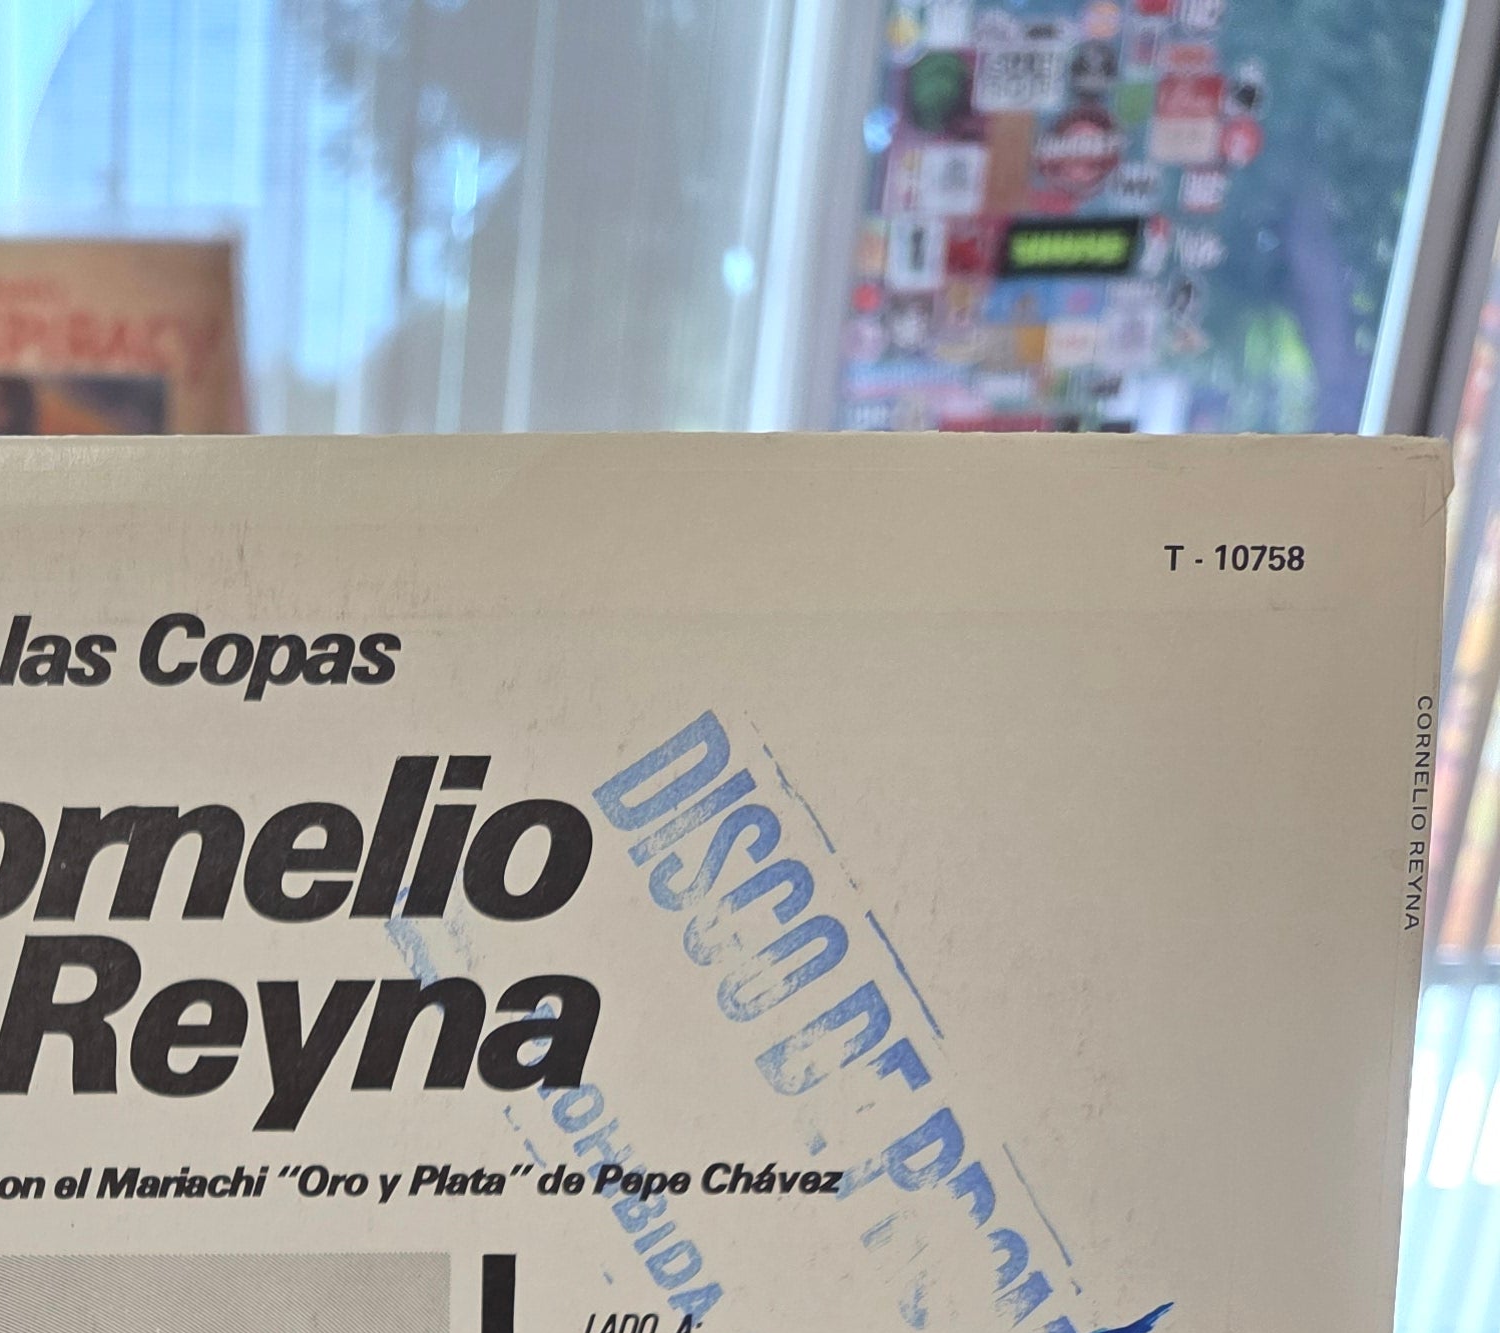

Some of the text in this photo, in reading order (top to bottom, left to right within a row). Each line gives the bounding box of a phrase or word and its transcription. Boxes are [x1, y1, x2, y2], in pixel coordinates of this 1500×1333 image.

[1163, 545, 1185, 571] T
[1215, 544, 1305, 572] 10758
[139, 612, 402, 701] Copas
[1403, 694, 1434, 931] CORNELIO REYNA
[592, 709, 849, 1025] DISCO
[54, 1167, 93, 1199] el
[96, 1166, 269, 1199] Mariachi
[378, 1174, 402, 1204] y
[537, 1164, 586, 1195] de
[593, 1163, 691, 1202] Pepe
[701, 1162, 844, 1194] Chávez
